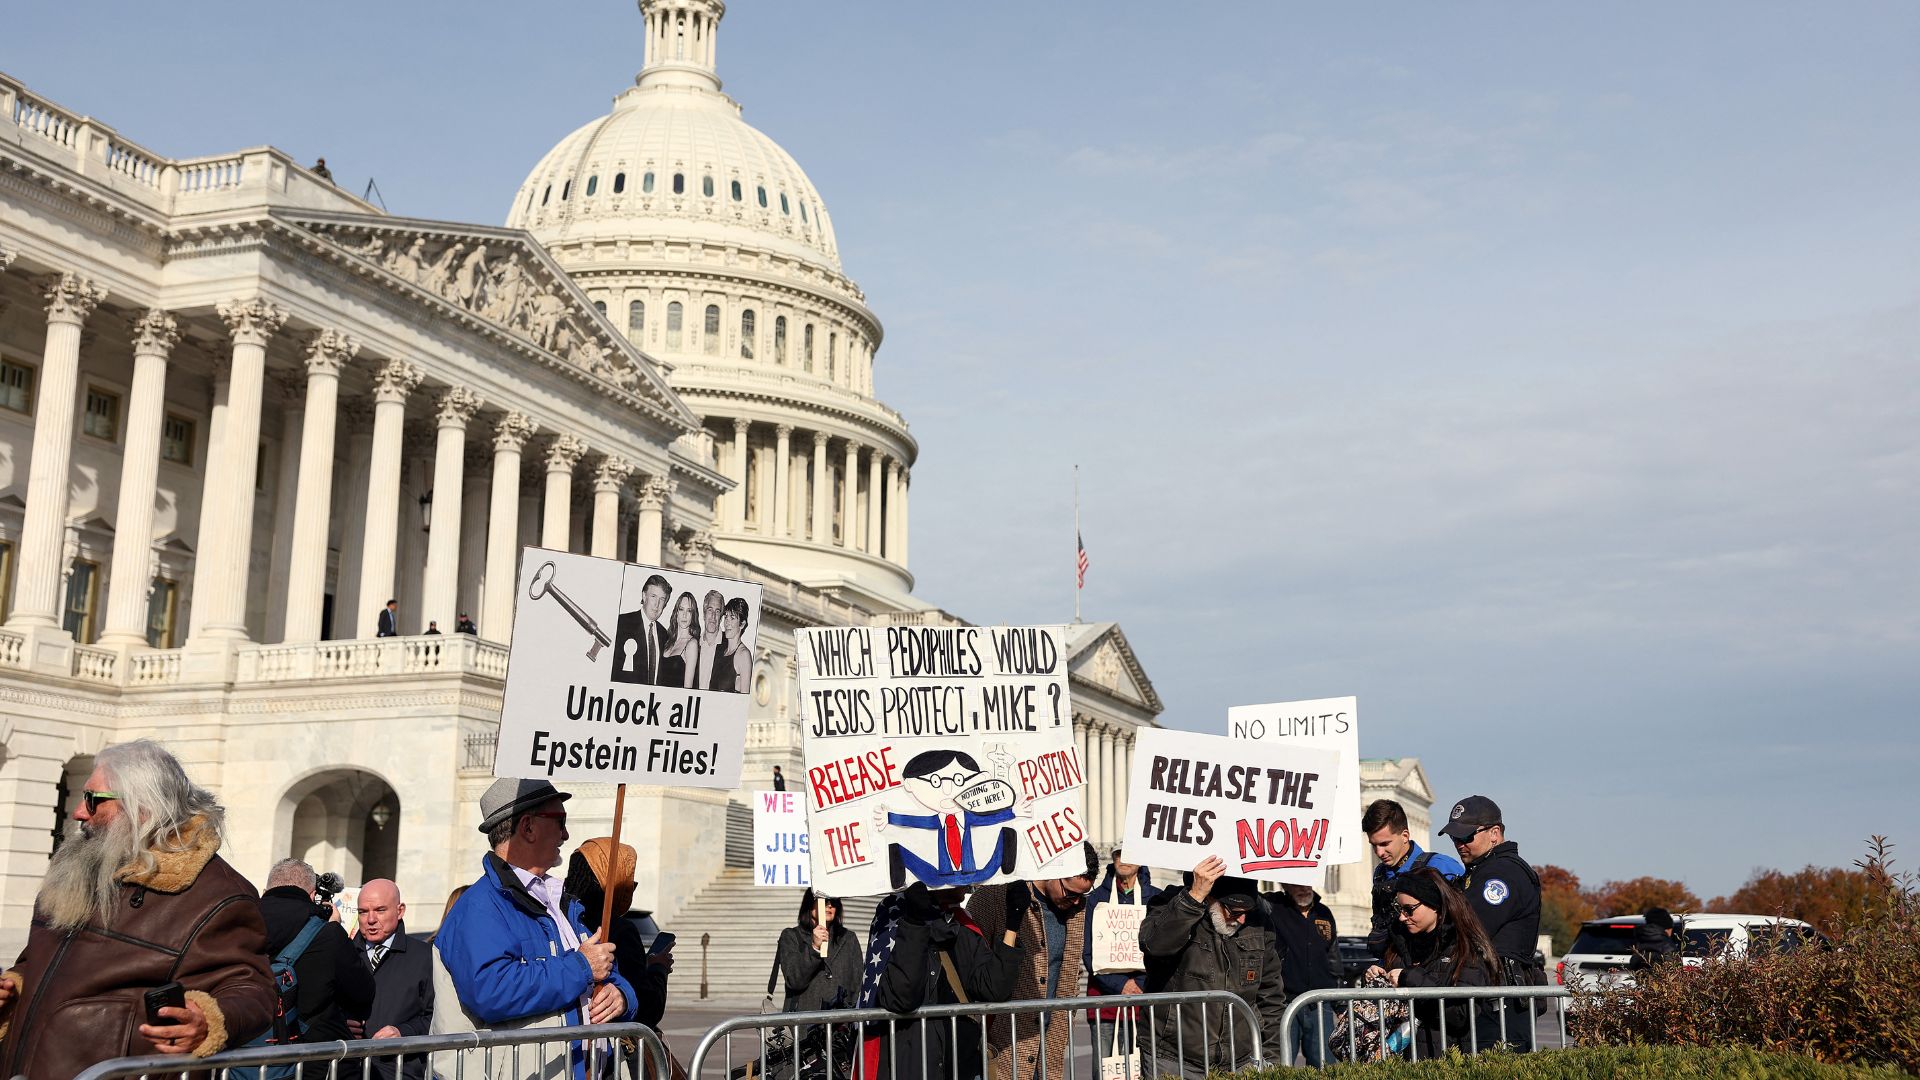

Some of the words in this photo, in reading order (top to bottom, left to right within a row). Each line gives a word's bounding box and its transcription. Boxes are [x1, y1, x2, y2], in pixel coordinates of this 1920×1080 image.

[808, 627, 874, 677] WHICH
[887, 626, 982, 676] PEDOPHILES
[991, 627, 1058, 675] WOULD
[566, 684, 661, 726] Unlock
[668, 696, 701, 729] all
[811, 688, 875, 737] JESUS
[1235, 719, 1265, 739] NO
[1278, 712, 1350, 737] LIMITS
[530, 730, 637, 776] Epstein
[647, 739, 718, 775] Files!
[809, 746, 901, 808] RELEASE
[1018, 746, 1083, 801] EPSTEIN
[1150, 755, 1261, 803] RELEASE
[1267, 768, 1319, 809] THE
[764, 793, 793, 813] WE
[961, 784, 988, 800] NOTHING
[991, 781, 1000, 790] TO
[967, 799, 981, 810] SEE
[985, 790, 1006, 805] HERE!
[766, 832, 810, 854] JUS
[824, 821, 866, 867] THE
[1026, 806, 1083, 863] FILES
[1142, 803, 1216, 846] FILES
[1235, 818, 1329, 860] NOW!
[762, 864, 809, 884] WIL
[1106, 920, 1140, 930] WOUL
[1107, 909, 1141, 919] WHAT
[1110, 941, 1138, 952] HAVE
[1112, 930, 1139, 942] YOU
[1110, 952, 1144, 963] DONE?
